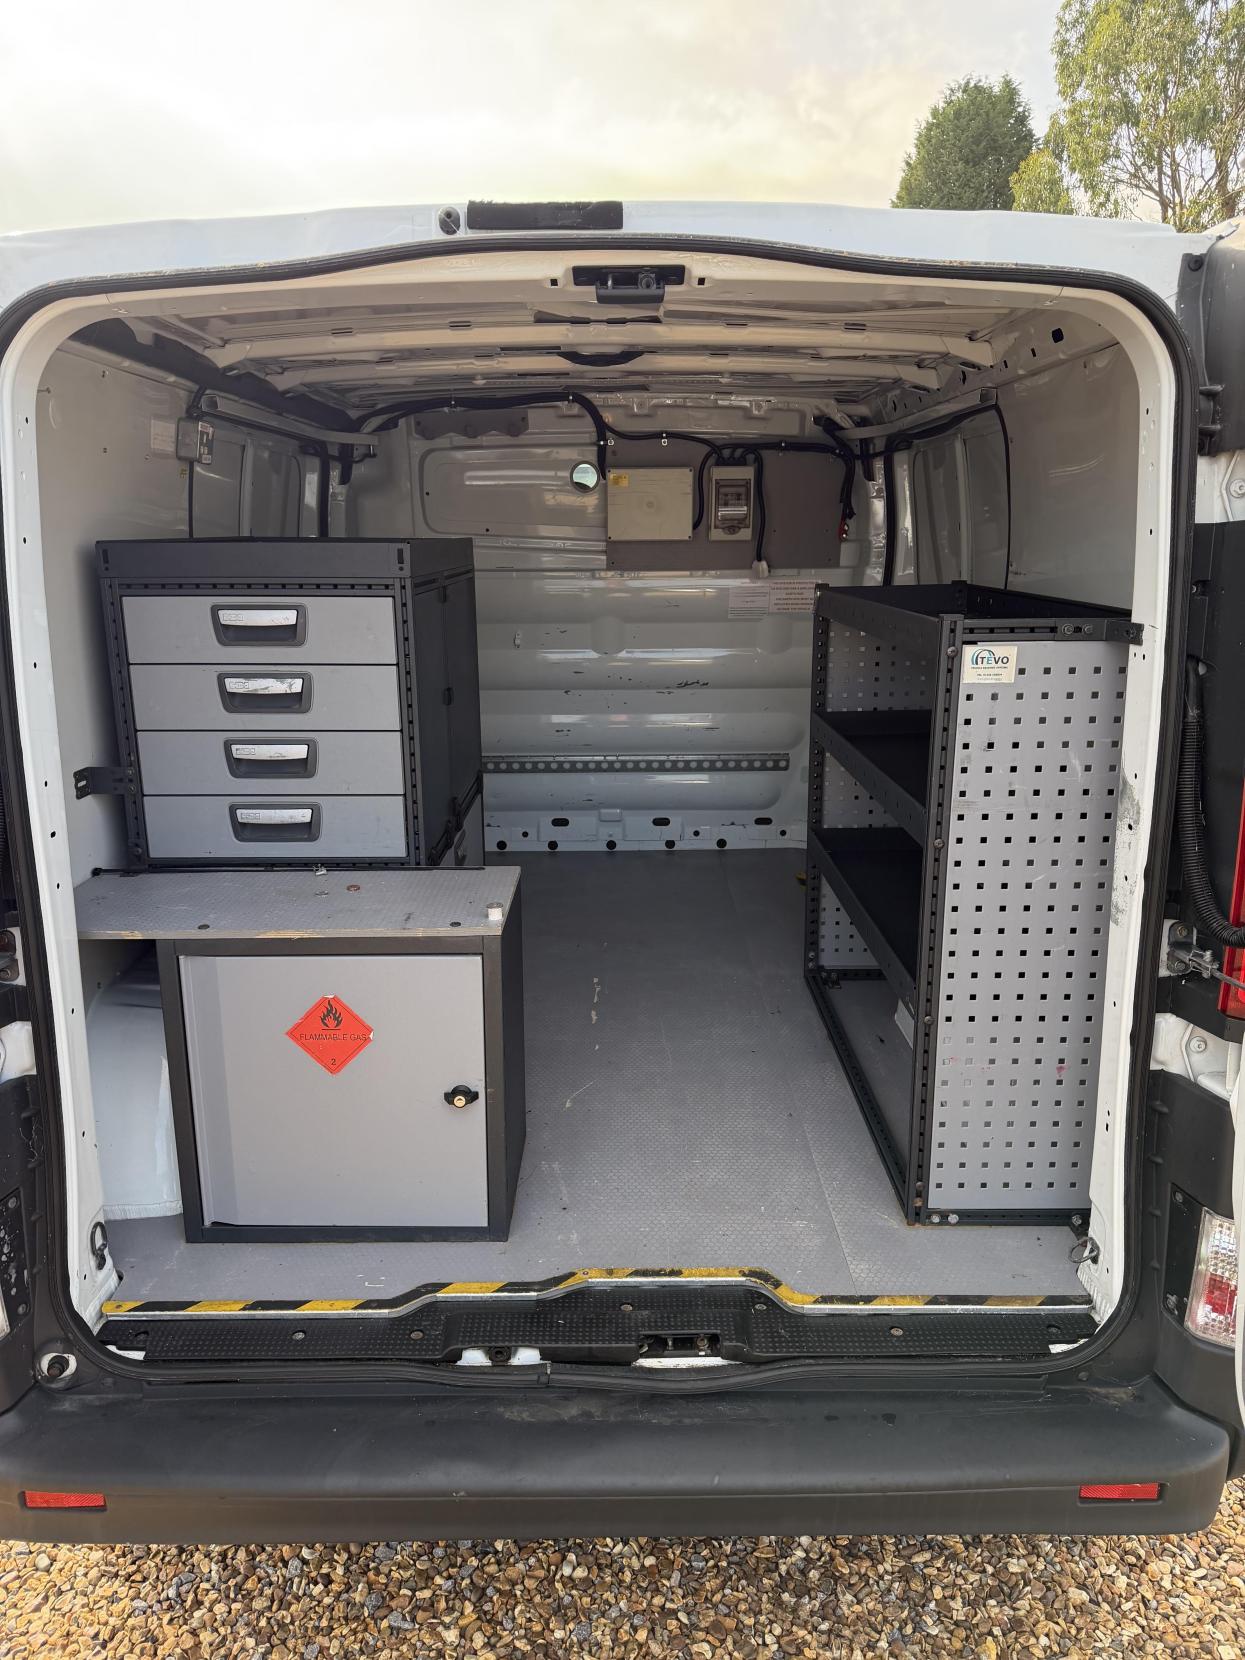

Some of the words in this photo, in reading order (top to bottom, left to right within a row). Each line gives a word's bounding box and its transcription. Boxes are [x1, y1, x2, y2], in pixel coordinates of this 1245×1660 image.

[979, 656, 1009, 665] TEVO
[299, 1033, 348, 1041] FLAMMABLE
[349, 1033, 367, 1041] GAS
[330, 1058, 336, 1066] 2
